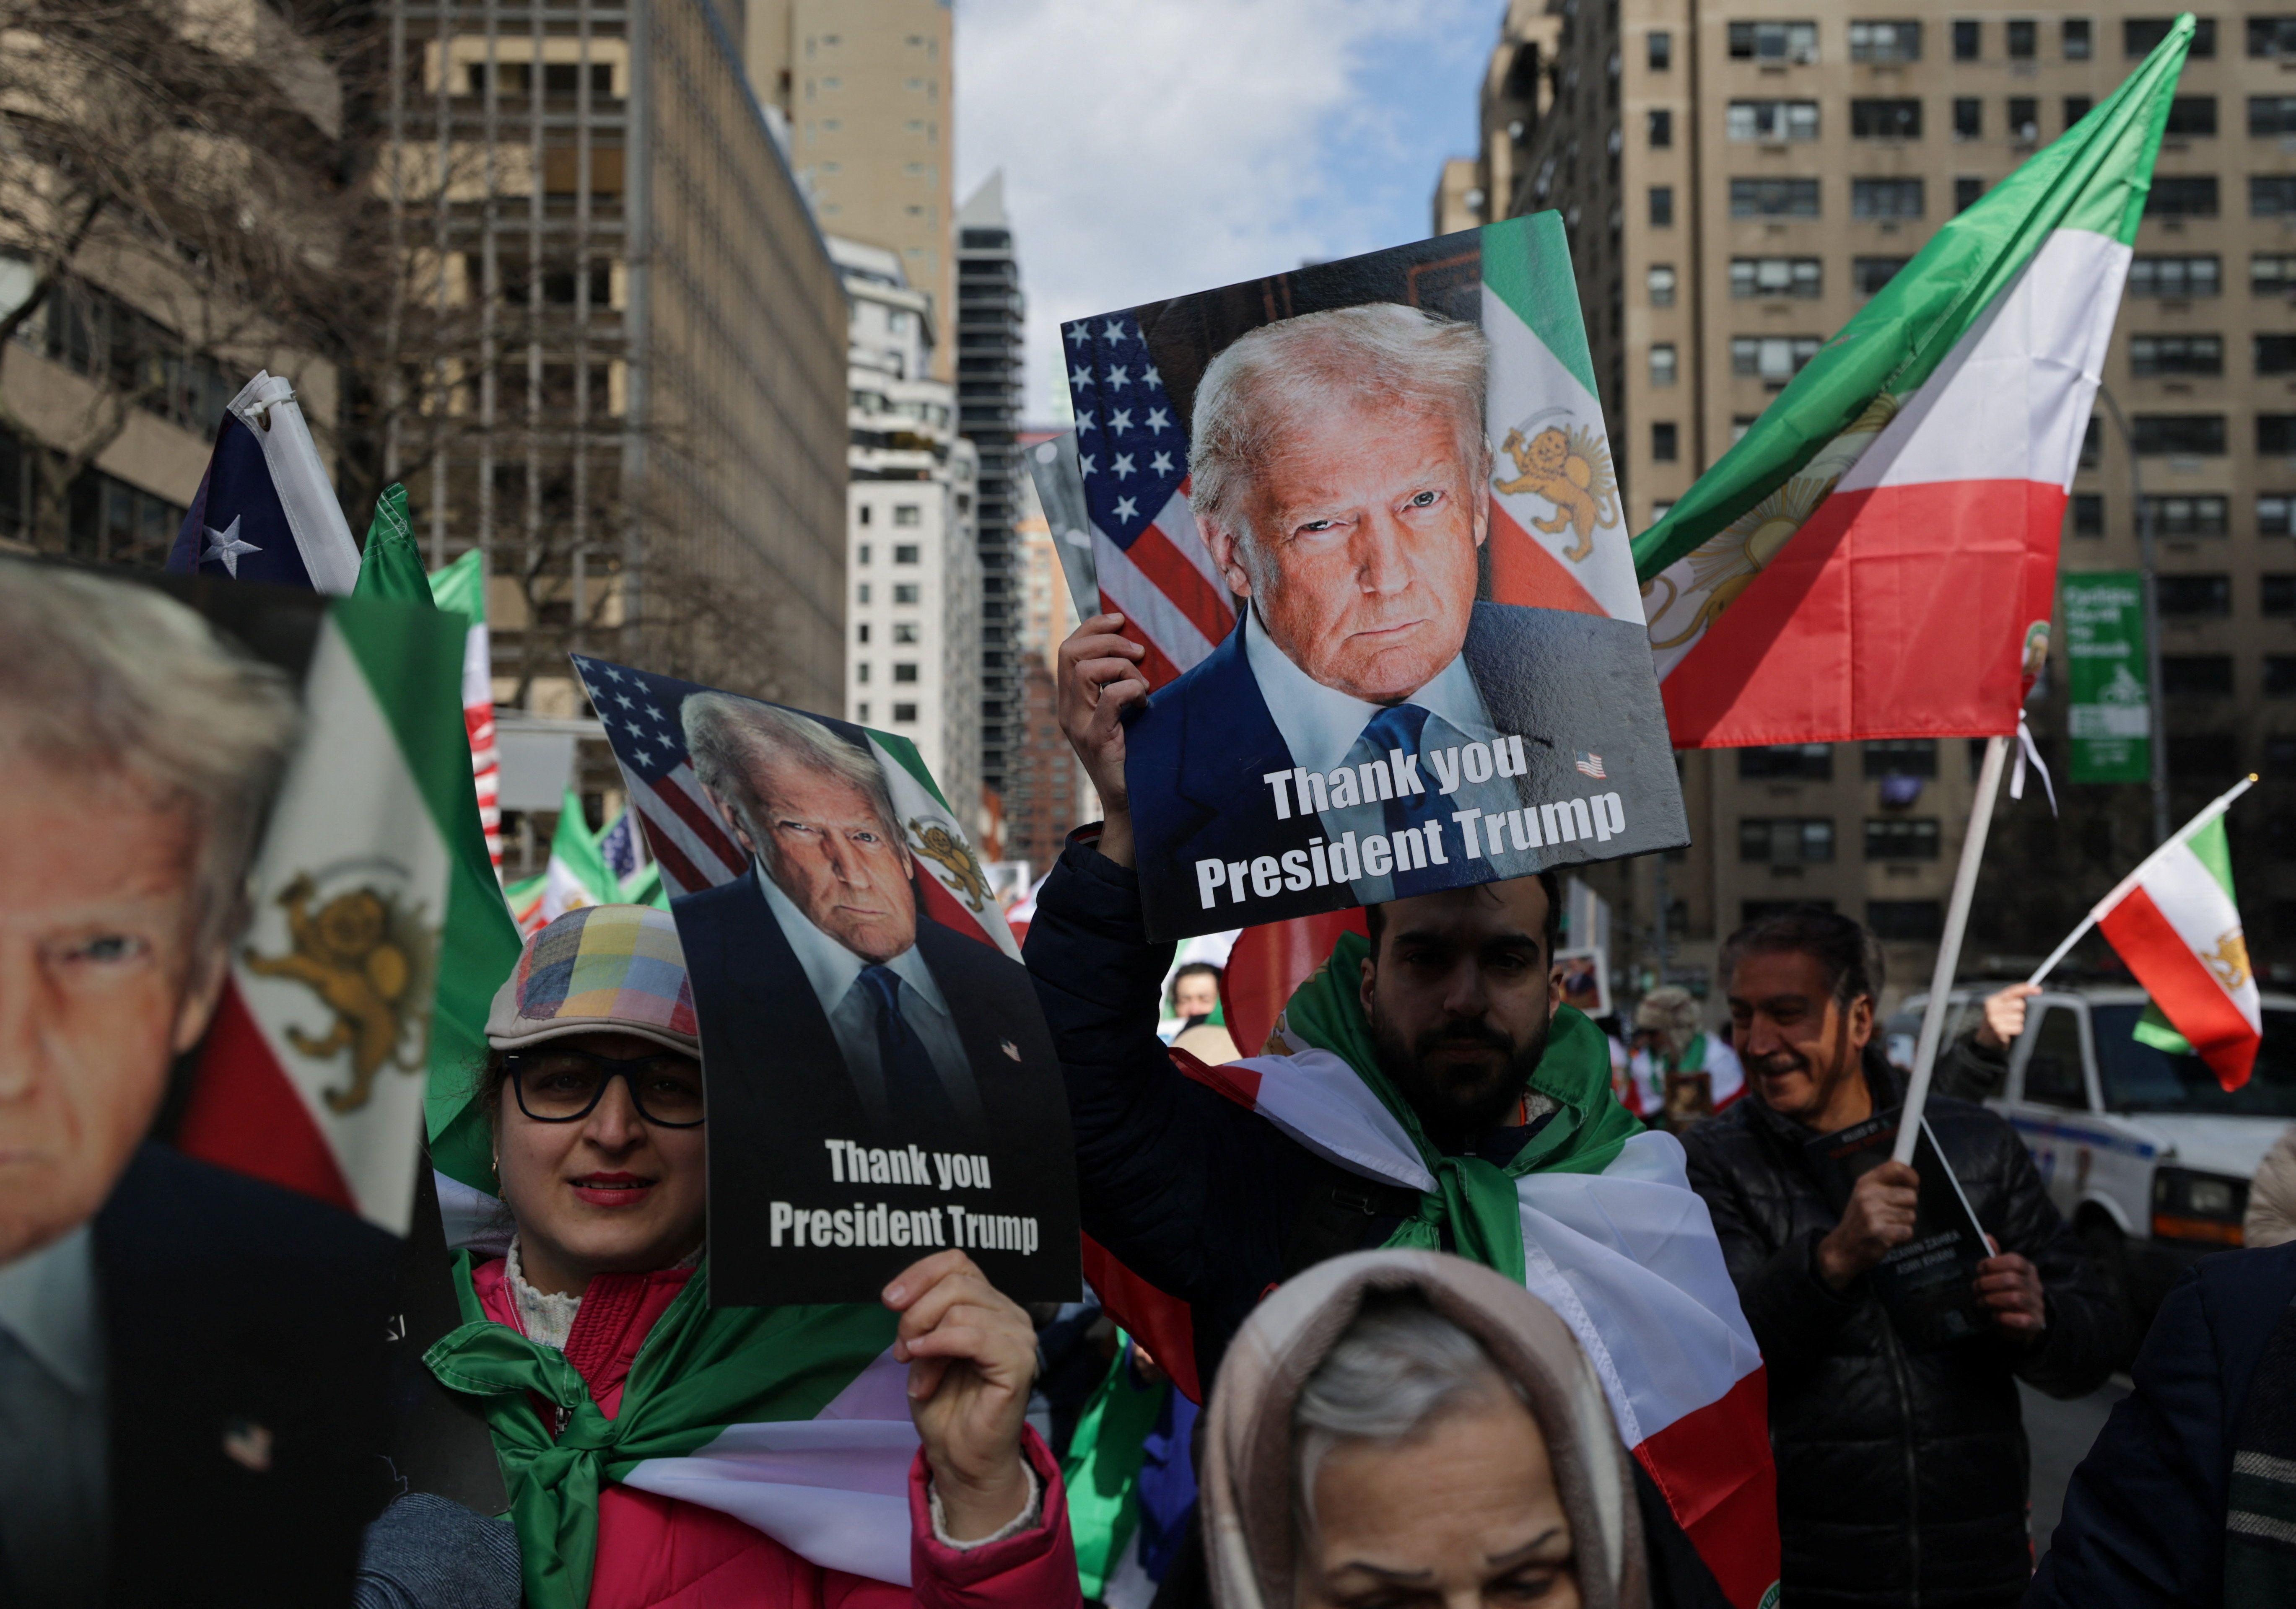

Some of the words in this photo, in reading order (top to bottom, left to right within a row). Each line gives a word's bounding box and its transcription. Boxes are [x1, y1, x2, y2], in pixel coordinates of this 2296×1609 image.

[1263, 749, 1425, 820] Thank
[1430, 735, 1527, 795] you
[1195, 819, 1448, 909] President
[1452, 792, 1625, 860] Trump
[825, 1139, 931, 1186] Thank
[933, 1152, 991, 1190] you
[770, 1202, 945, 1247] President
[947, 1205, 1038, 1255] Trump
